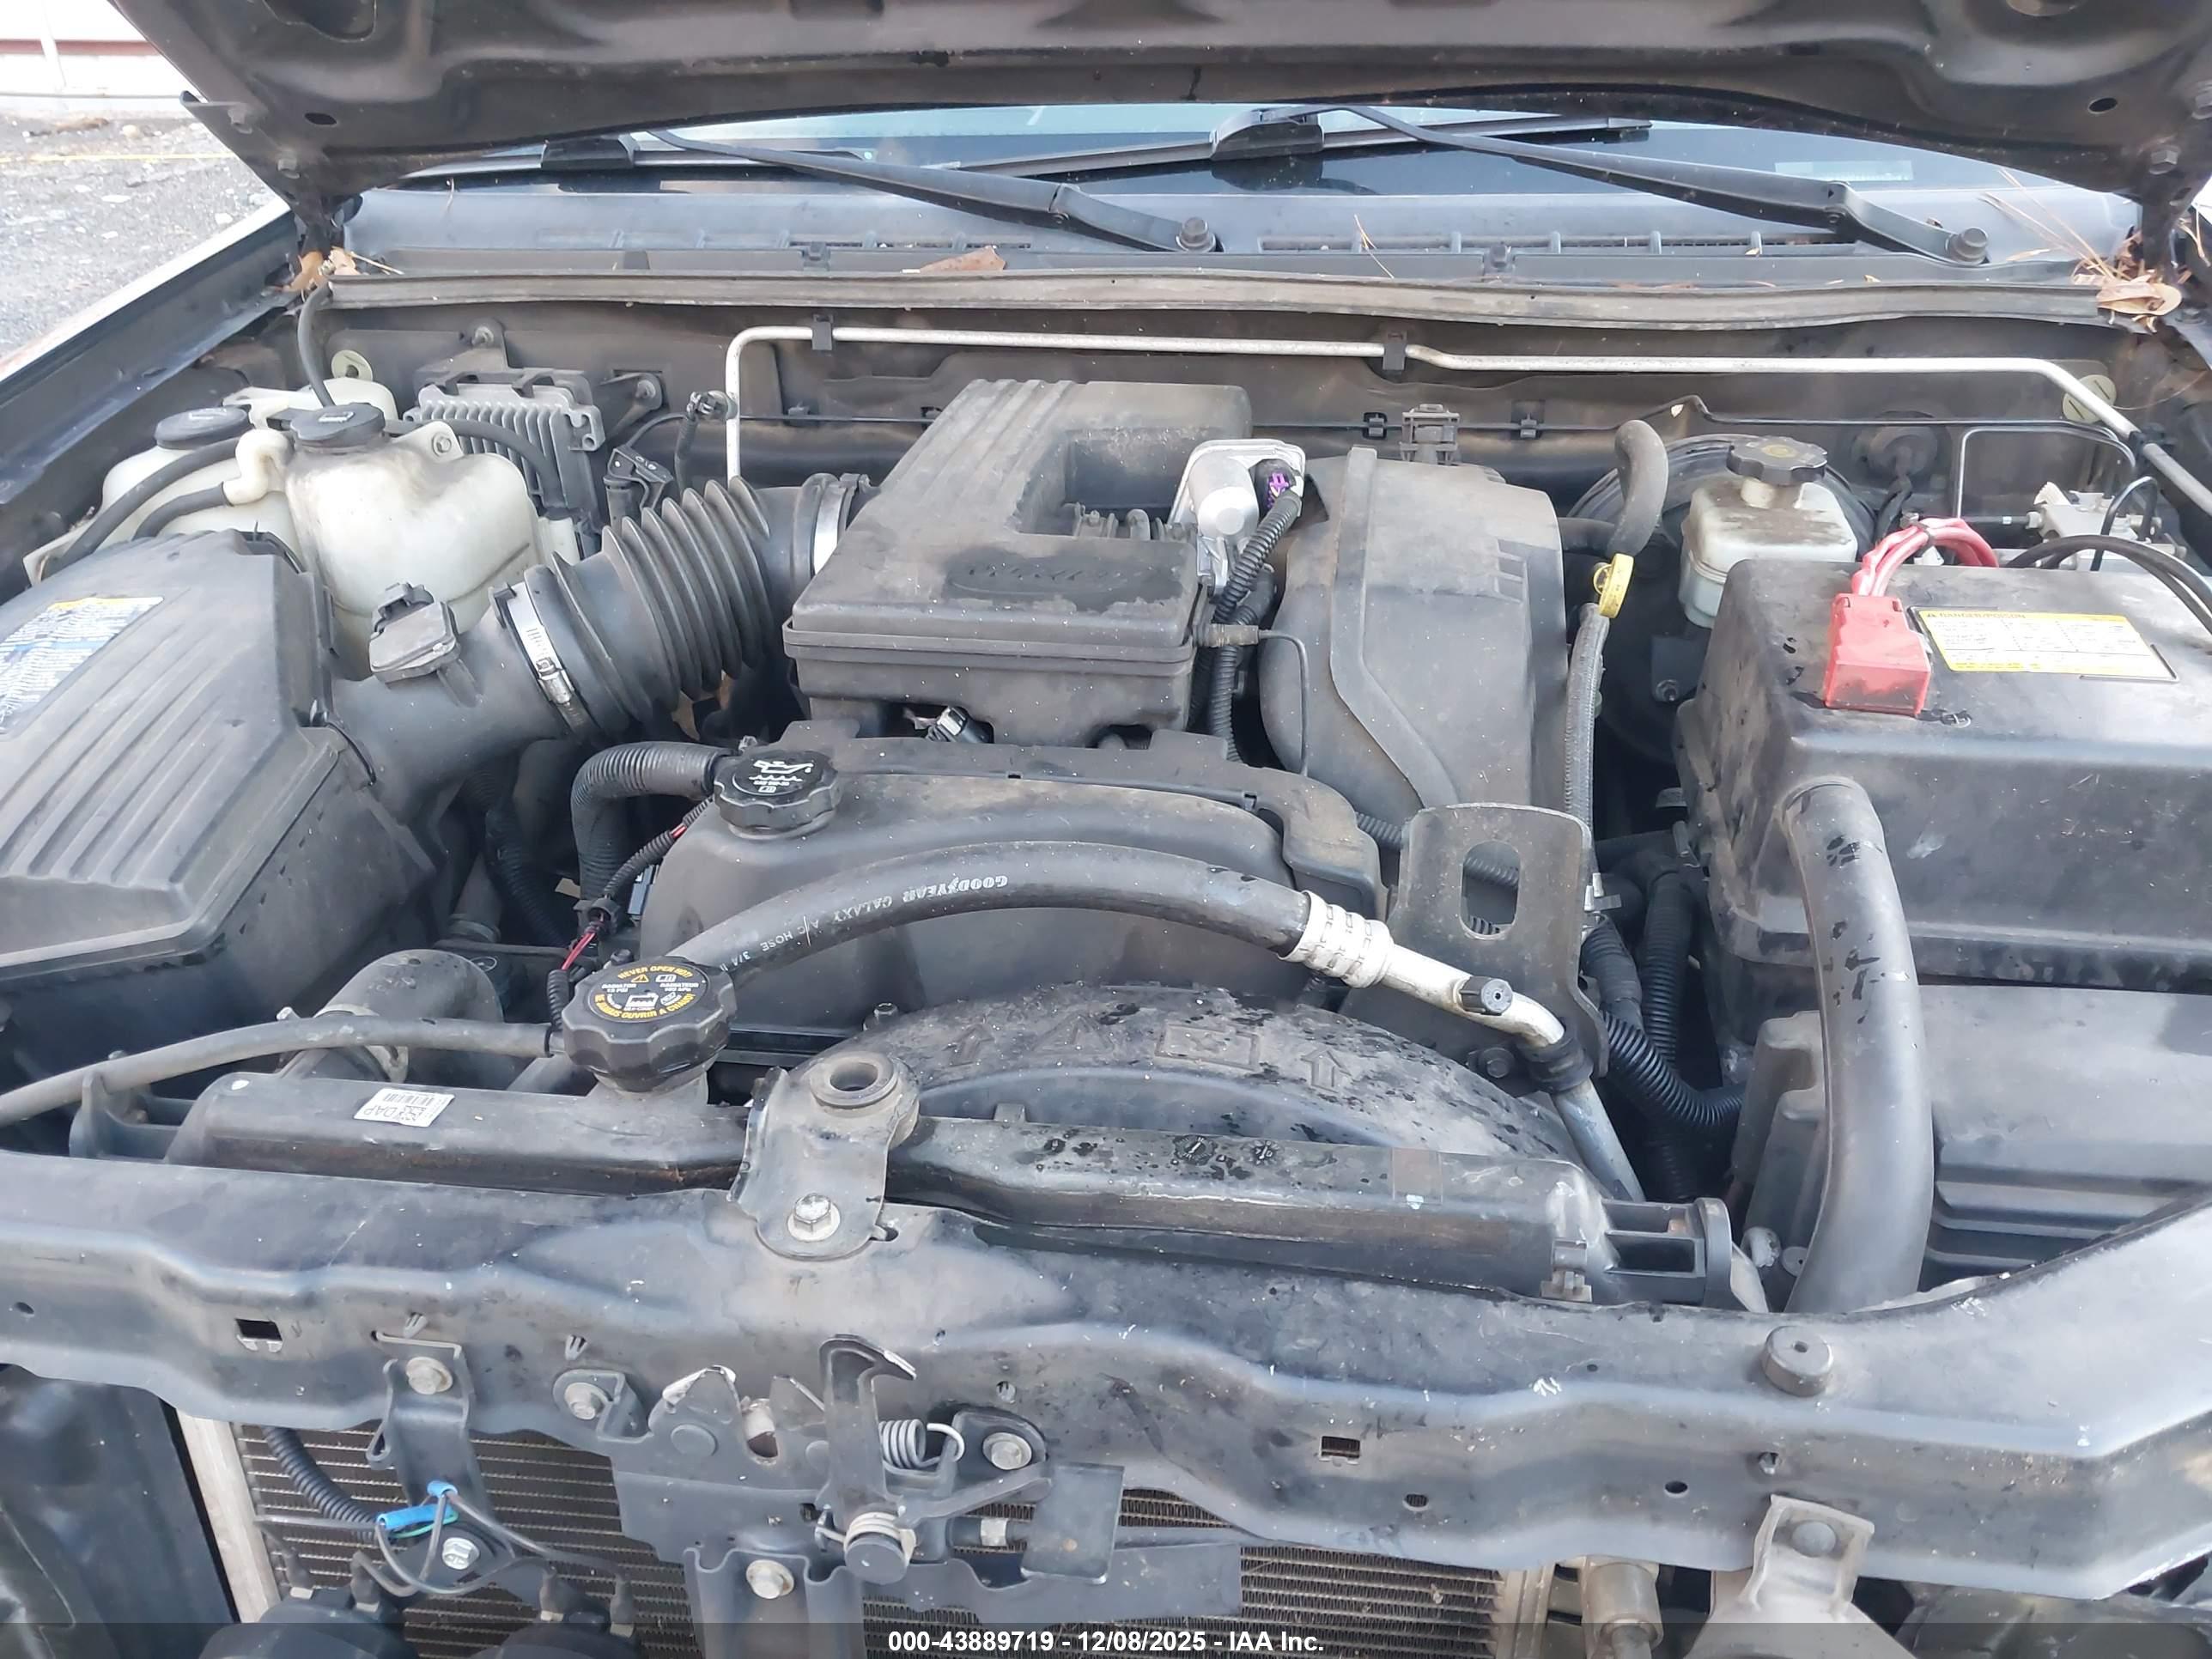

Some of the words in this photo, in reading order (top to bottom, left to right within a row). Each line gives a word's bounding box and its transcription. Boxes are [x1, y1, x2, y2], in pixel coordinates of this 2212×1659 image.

[902, 874, 1009, 904] GOODYEAR
[833, 895, 893, 923] GALAXY
[759, 930, 793, 952] HOSE
[617, 967, 648, 979] NEVER
[621, 1010, 658, 1019] OUVRIR
[363, 1104, 399, 1118] DAP
